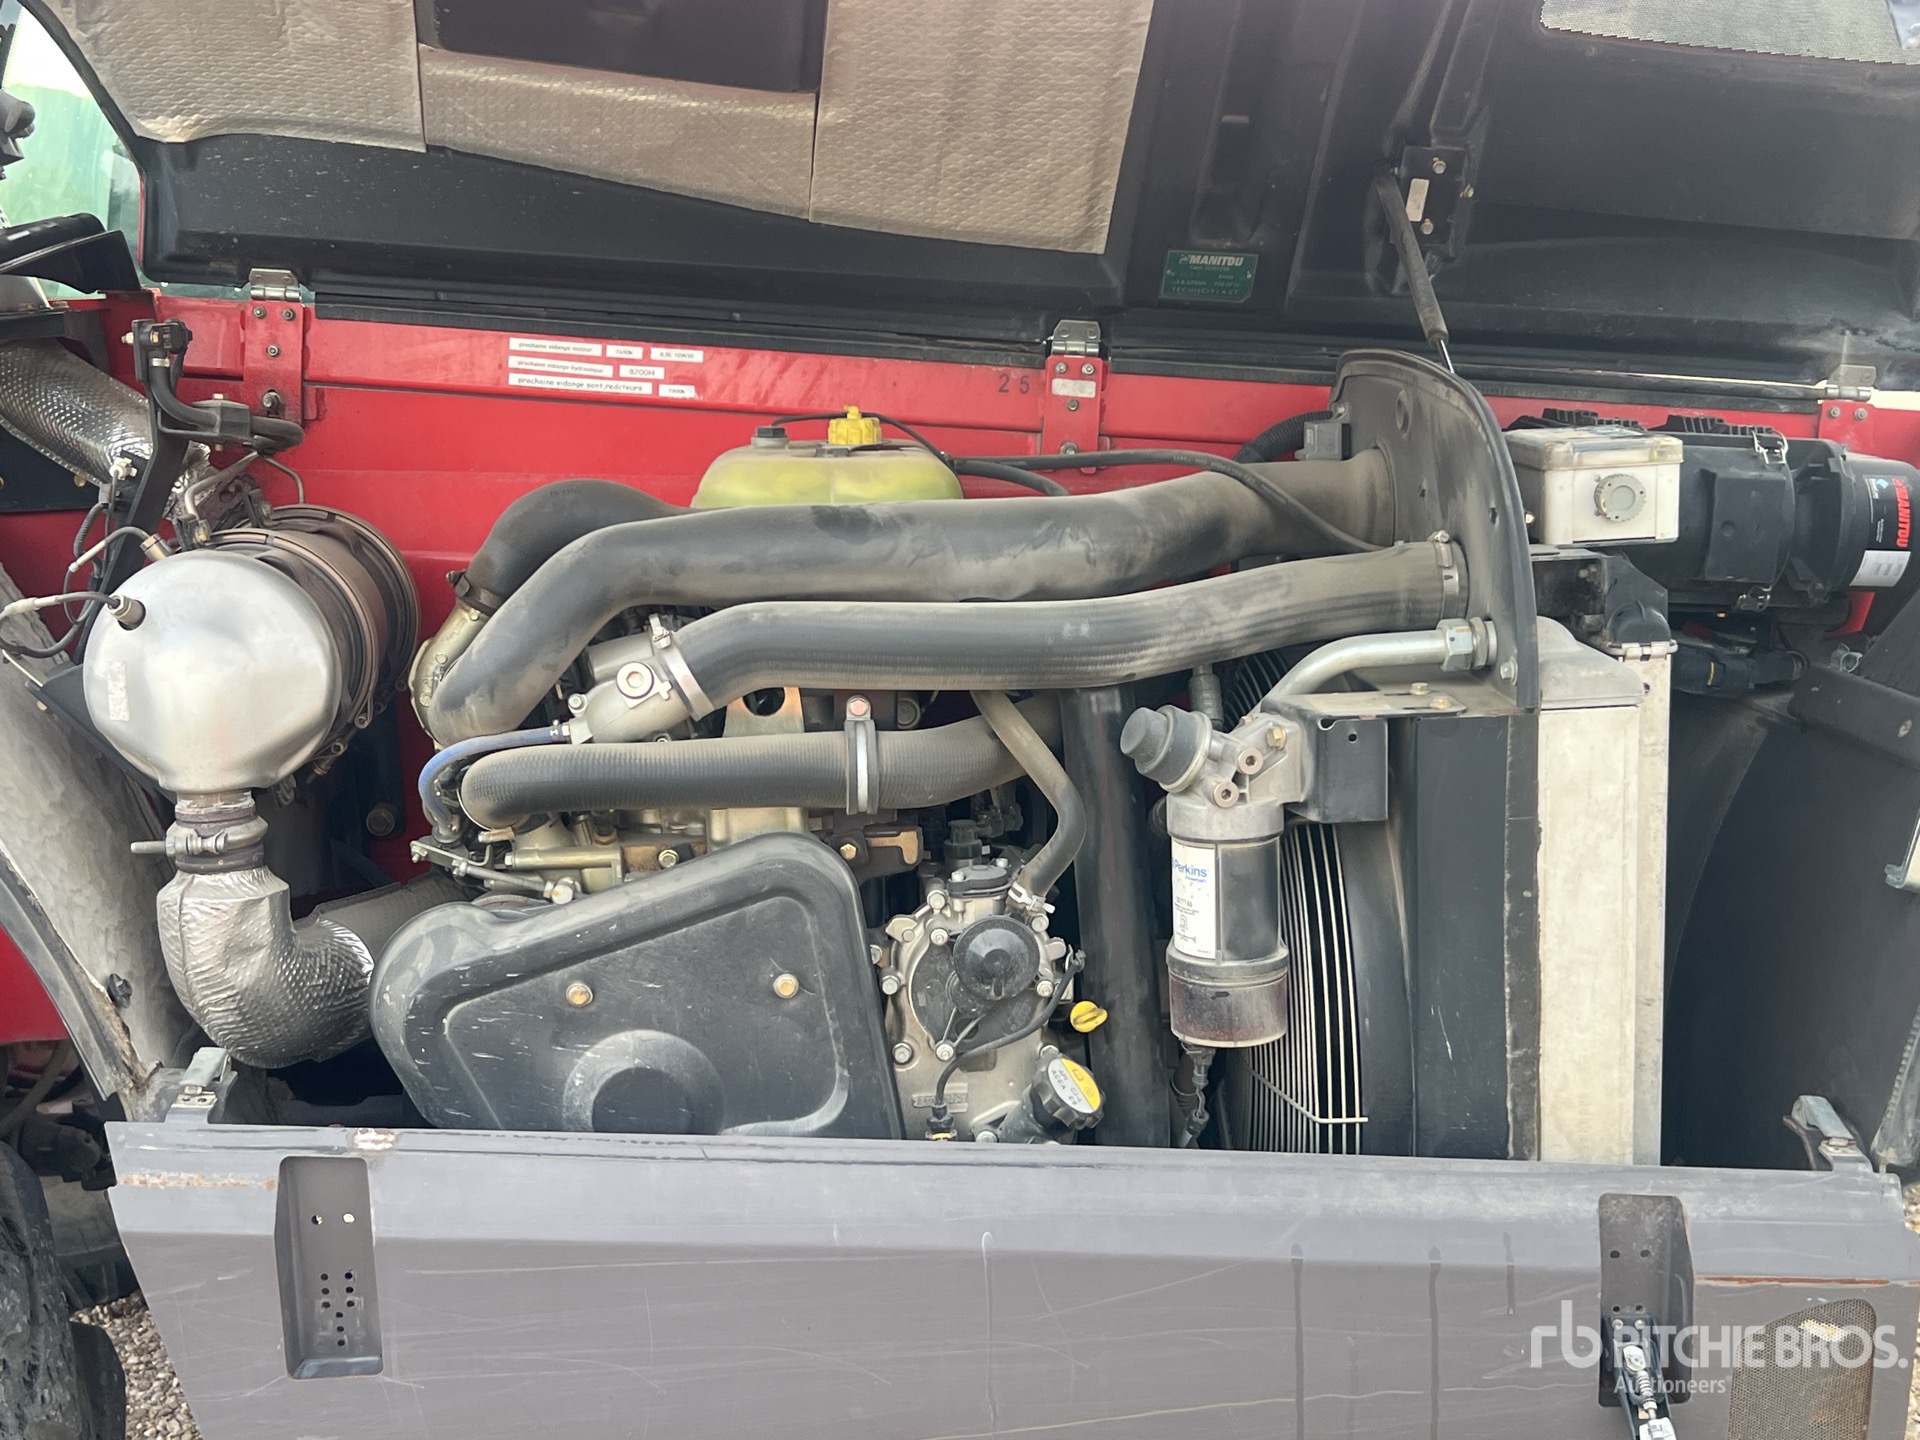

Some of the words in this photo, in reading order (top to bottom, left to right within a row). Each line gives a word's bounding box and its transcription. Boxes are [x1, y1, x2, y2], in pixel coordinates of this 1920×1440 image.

[1189, 254, 1244, 266] MANITOU
[518, 378, 555, 387] prochaine
[556, 379, 584, 389] vidange
[1895, 485, 1910, 547] MANITOU
[1173, 860, 1208, 878] Perkins
